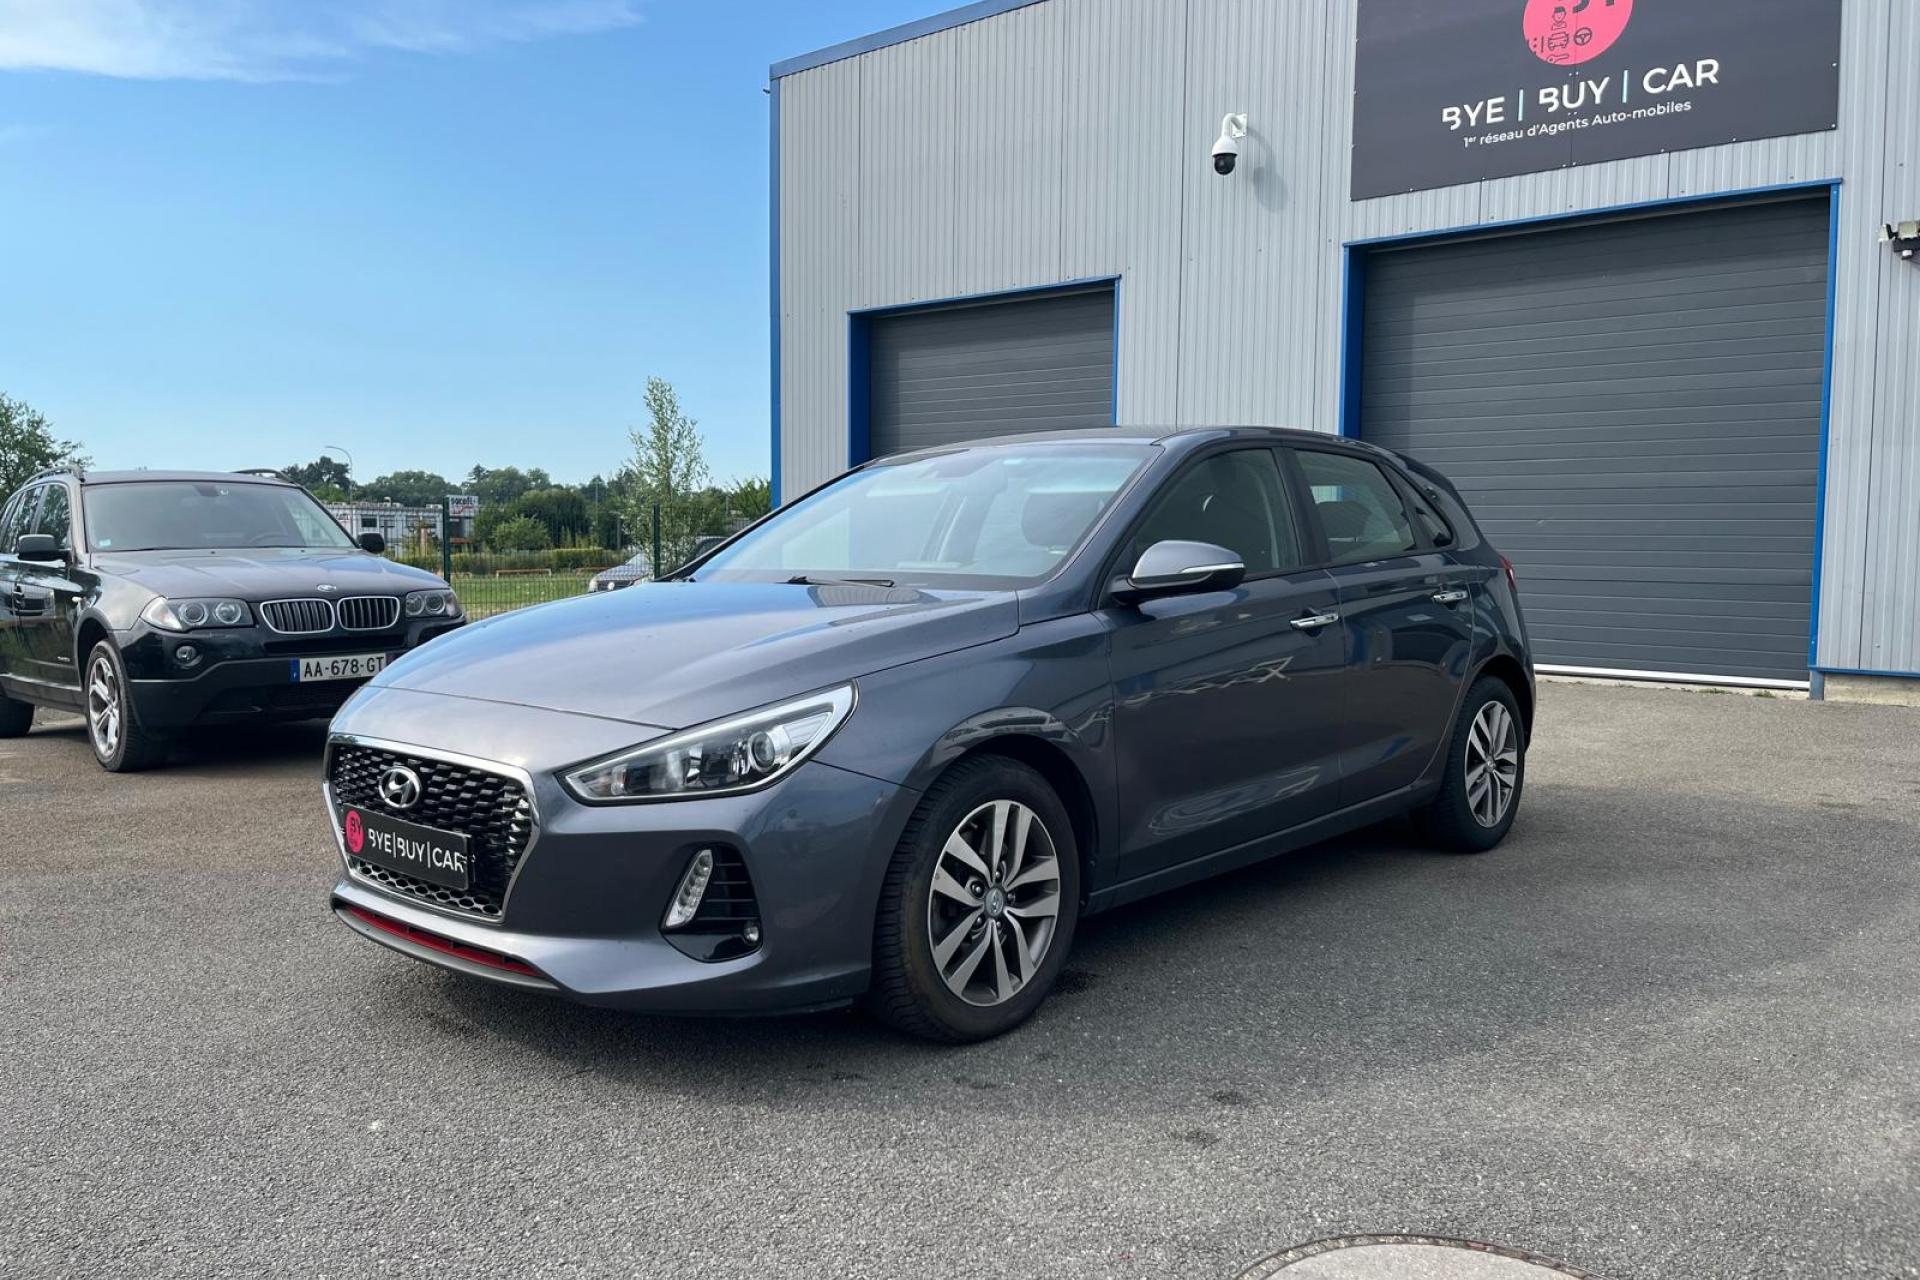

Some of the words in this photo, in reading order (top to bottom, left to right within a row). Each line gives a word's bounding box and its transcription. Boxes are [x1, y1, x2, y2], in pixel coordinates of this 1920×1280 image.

[1442, 96, 1505, 130] BYE
[1538, 76, 1610, 112] BUY
[1643, 58, 1719, 94] CAR
[1480, 129, 1523, 145] réseau
[1527, 117, 1589, 137] d'Agents
[1592, 101, 1692, 126] Auto-mobiles
[304, 656, 385, 678] AA-678-GT
